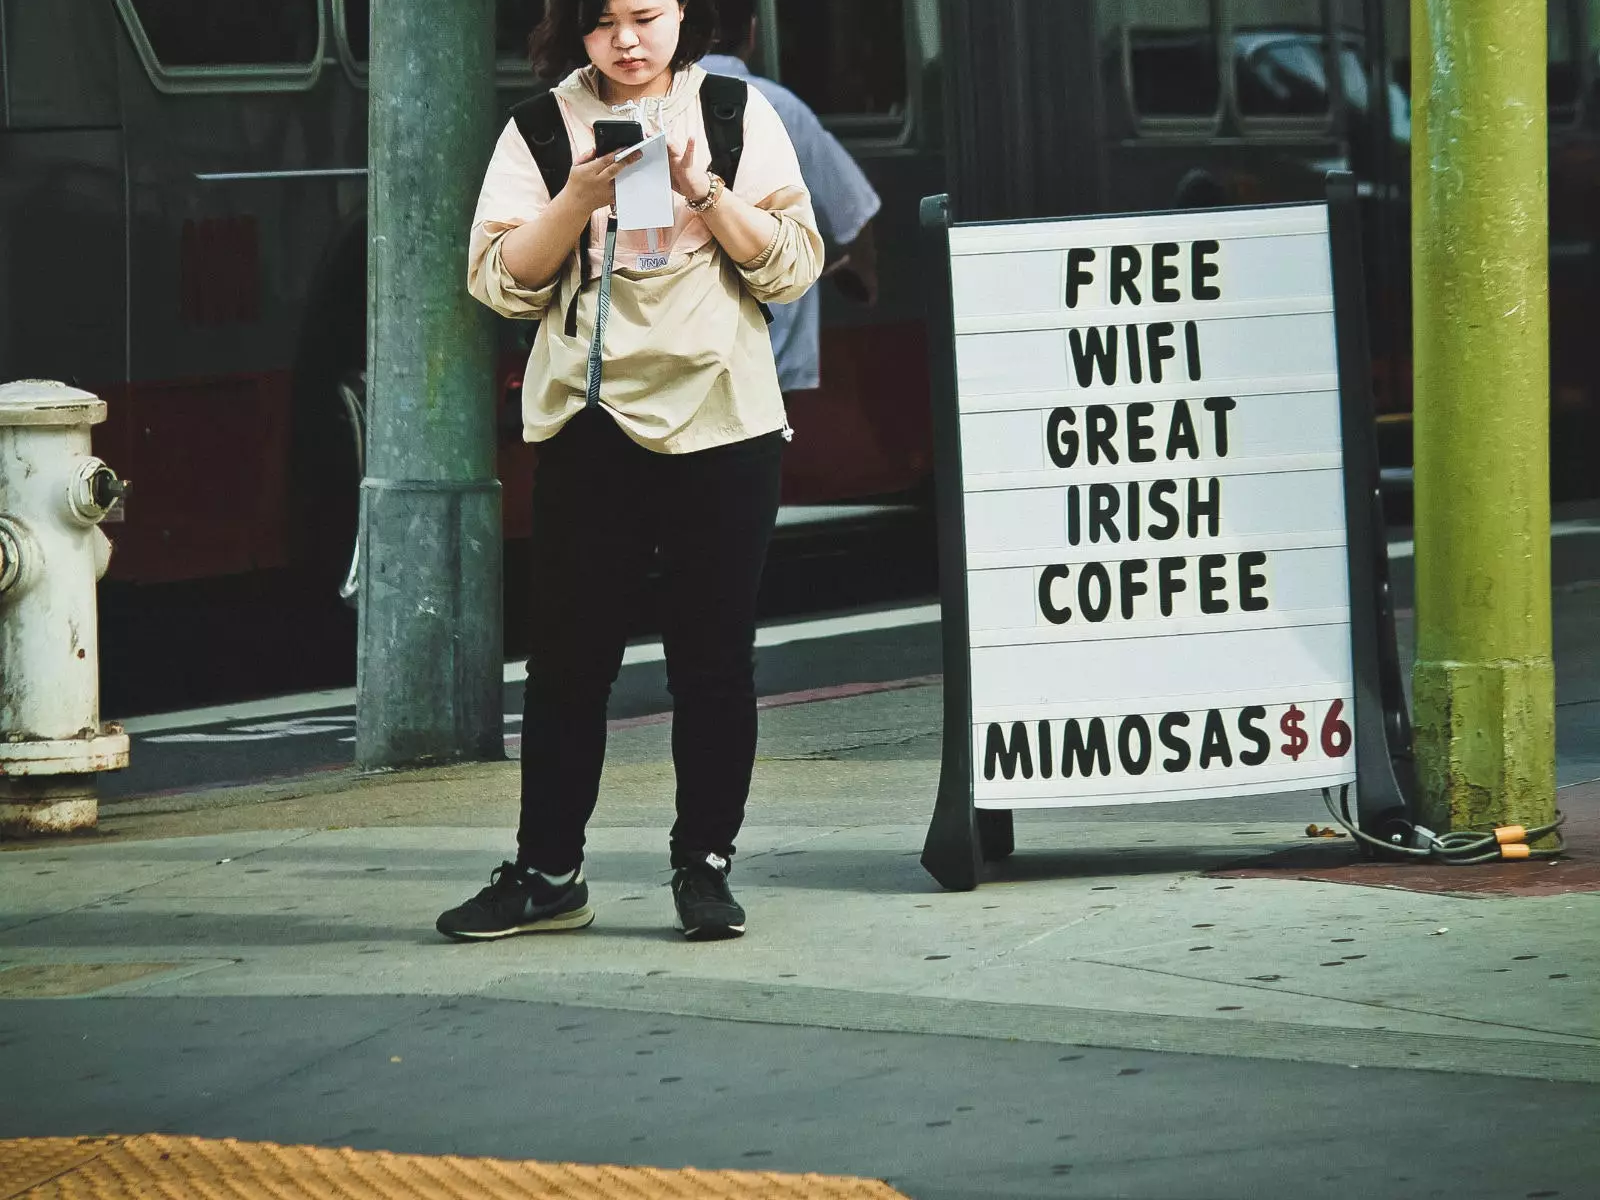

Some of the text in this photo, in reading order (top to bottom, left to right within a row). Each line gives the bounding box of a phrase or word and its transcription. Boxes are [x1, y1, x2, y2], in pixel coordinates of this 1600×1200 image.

[639, 256, 668, 268] TNA
[1065, 239, 1221, 309] FREE
[1068, 319, 1202, 389] WIFI
[1046, 396, 1237, 469] GREAT
[1067, 475, 1220, 546] IRISH
[1036, 550, 1269, 625] COFFEE
[983, 698, 1352, 781] MIMOSAS $6
